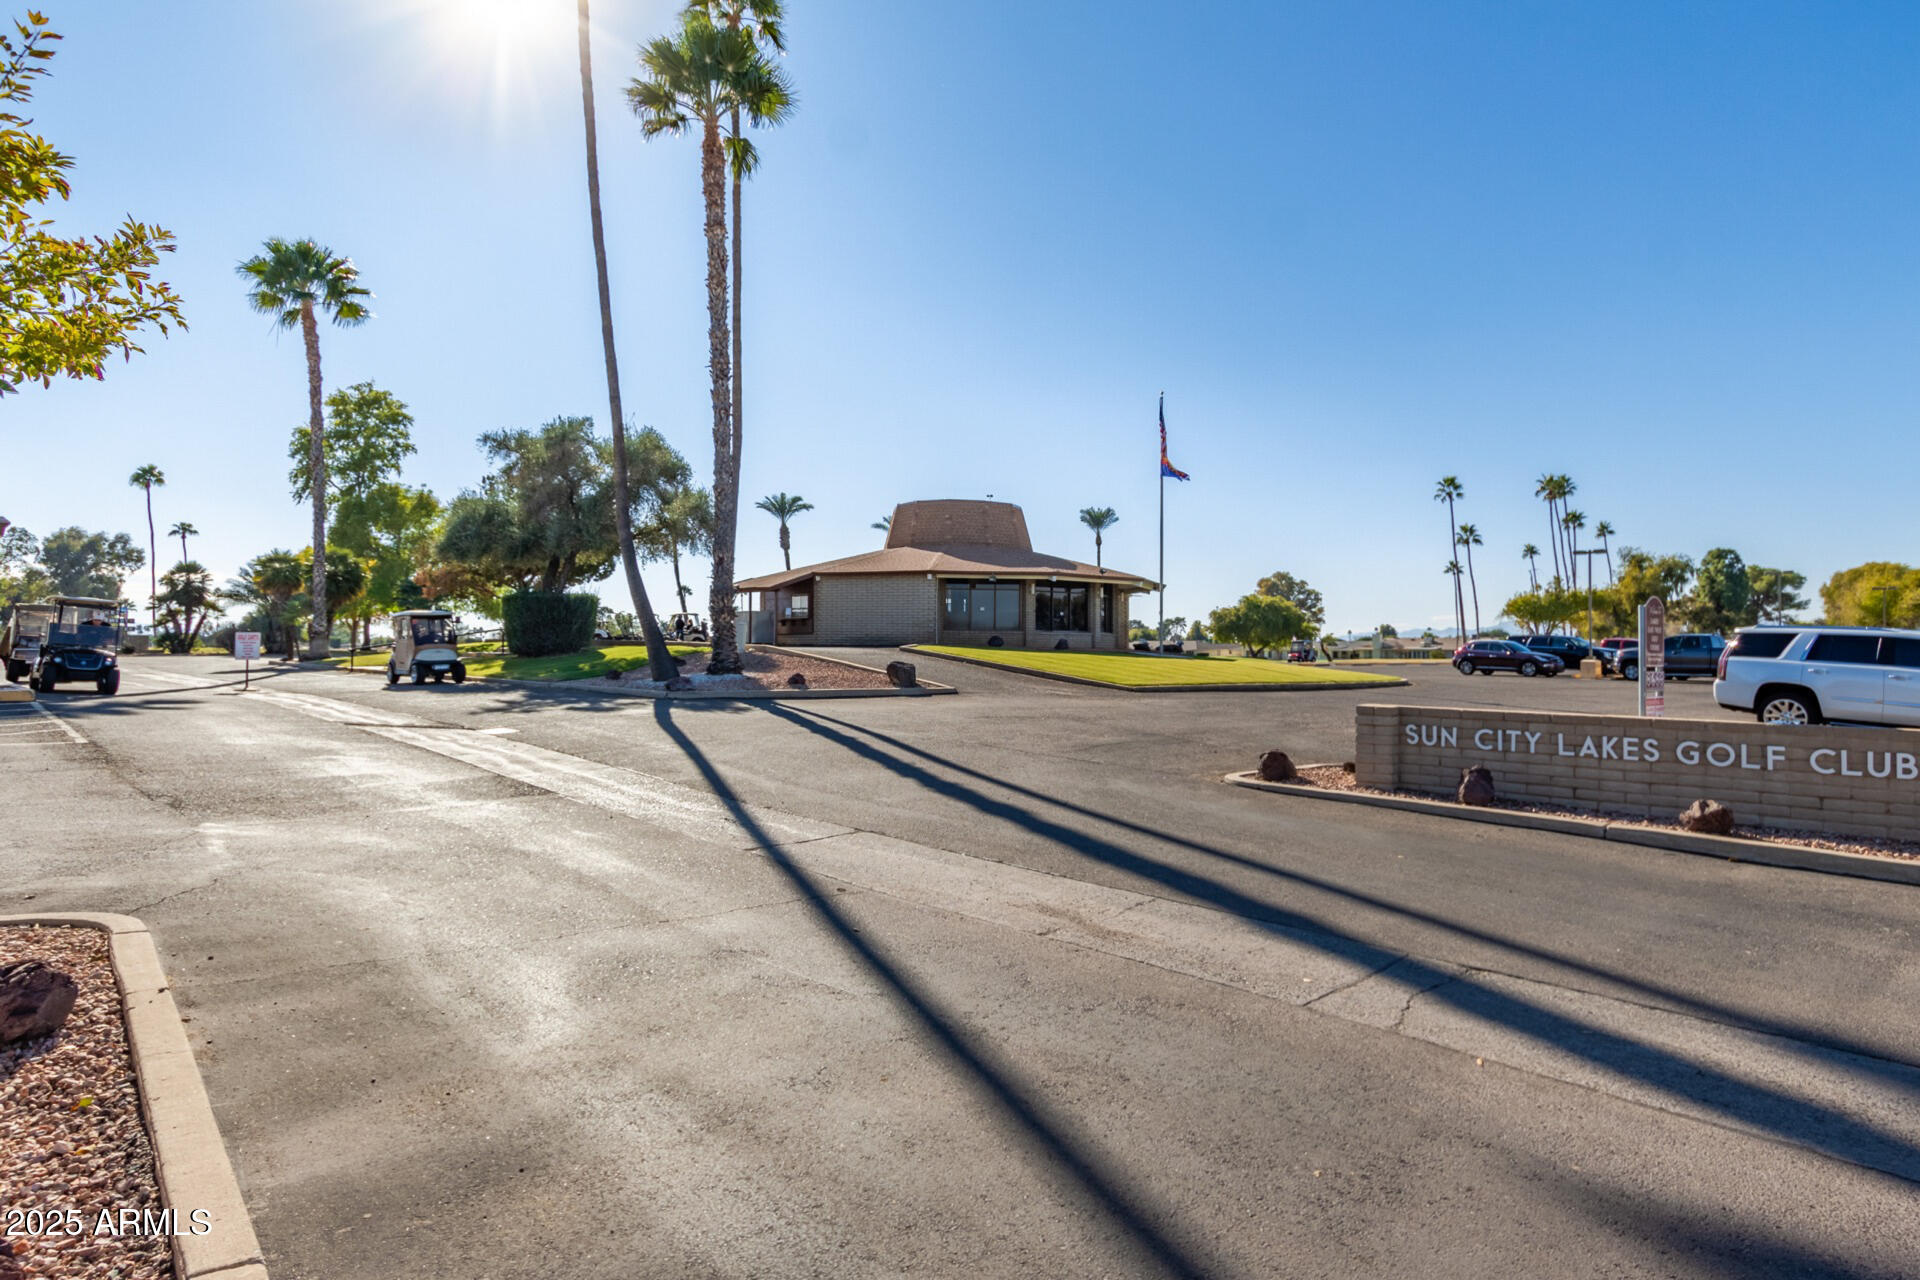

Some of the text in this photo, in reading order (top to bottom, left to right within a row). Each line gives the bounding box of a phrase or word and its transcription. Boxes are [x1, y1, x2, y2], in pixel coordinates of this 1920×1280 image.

[1405, 724, 1919, 780] SUN CITY LAKES GOLF CLUB
